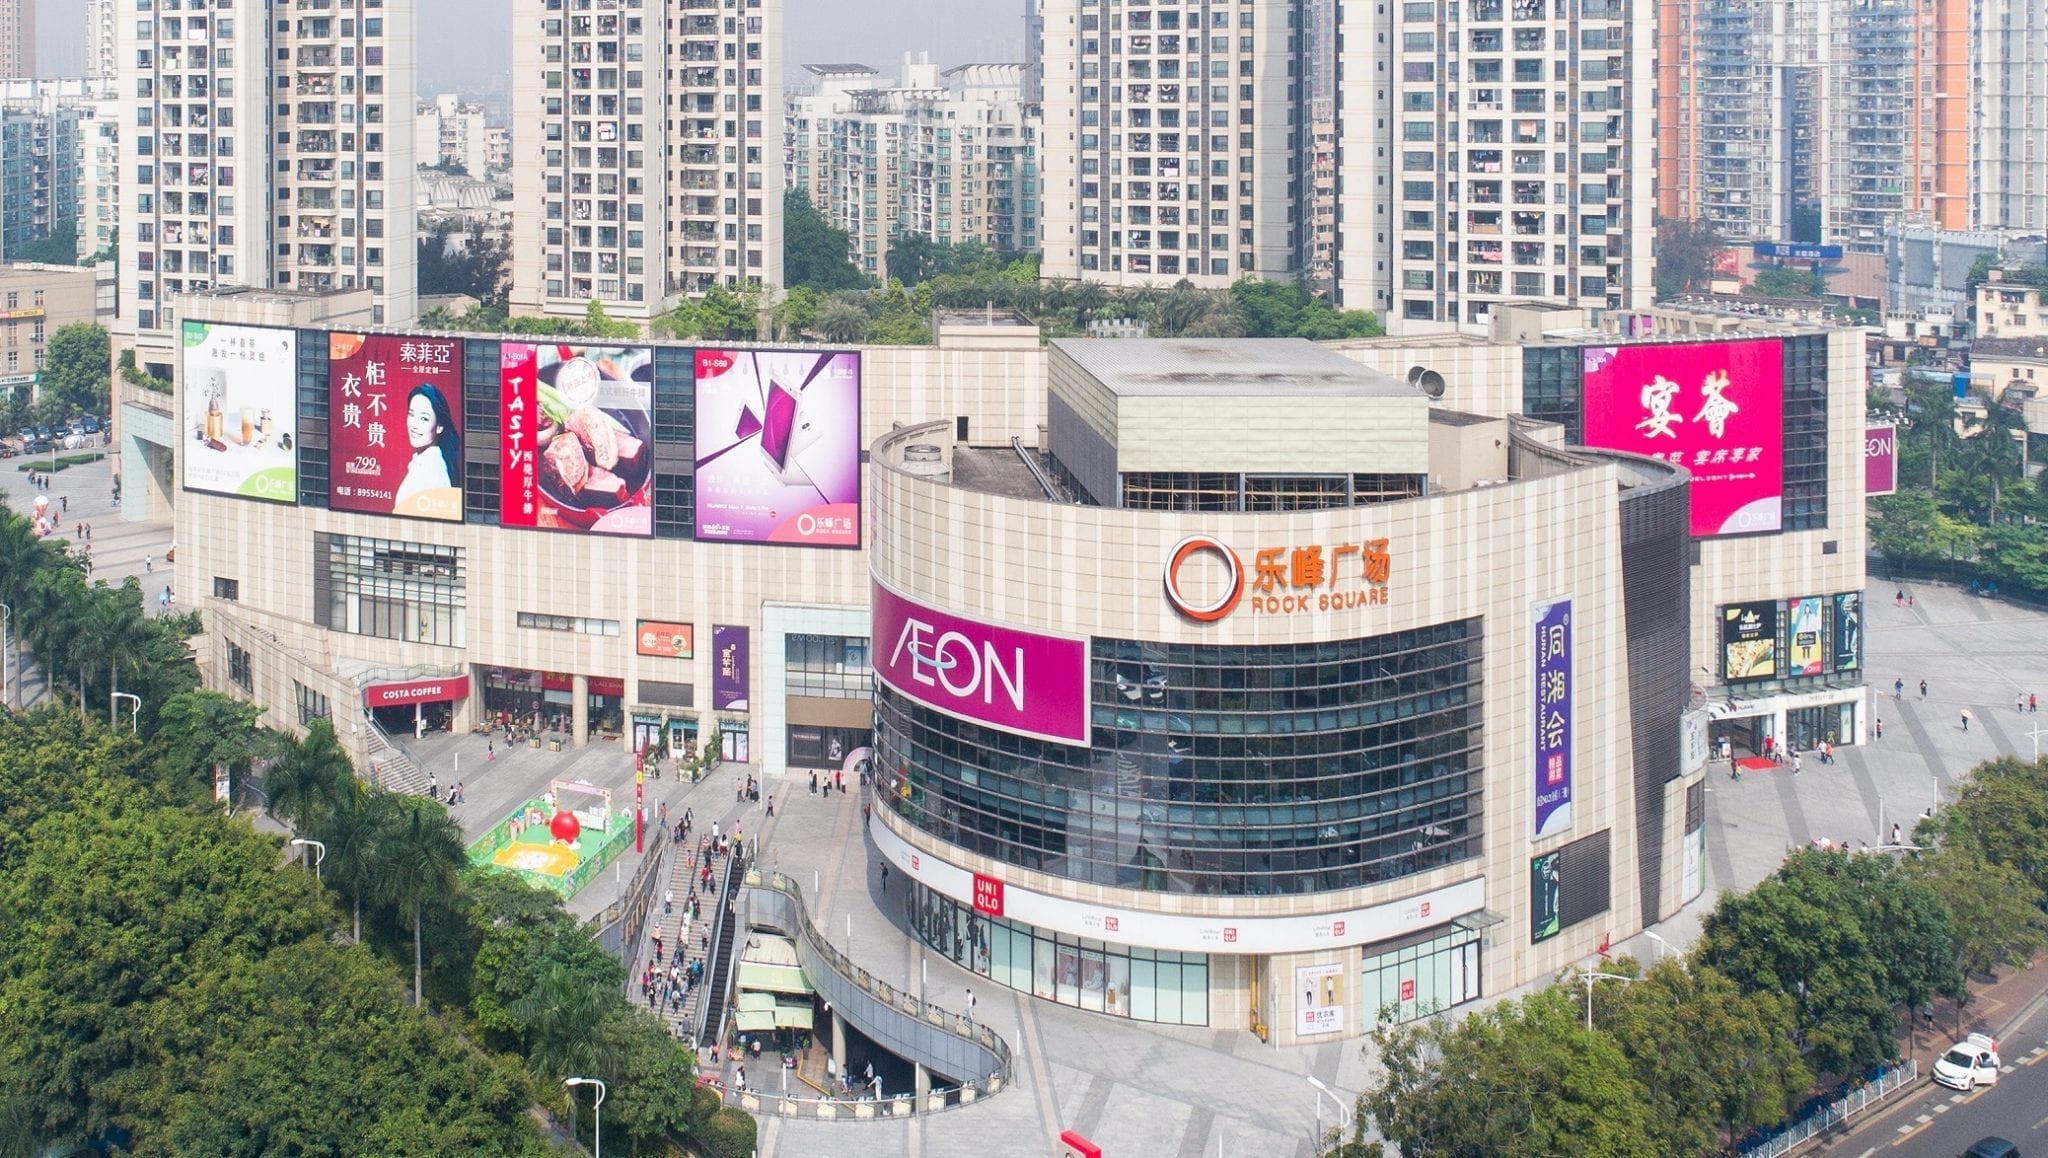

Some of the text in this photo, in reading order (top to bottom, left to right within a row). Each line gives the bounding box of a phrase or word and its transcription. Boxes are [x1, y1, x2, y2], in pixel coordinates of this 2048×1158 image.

[340, 372, 362, 429] 衣贵
[365, 360, 388, 449] 柜不贵
[507, 376, 525, 470] TASTY
[355, 456, 378, 473] 799
[815, 517, 852, 530] 乐峰广场
[1252, 537, 1391, 593] 乐峰广场
[1252, 586, 1389, 615] ROOK SQUARE
[383, 686, 442, 700] COSTA COFFEE
[977, 879, 997, 896] UNI
[977, 893, 998, 910] QLO
